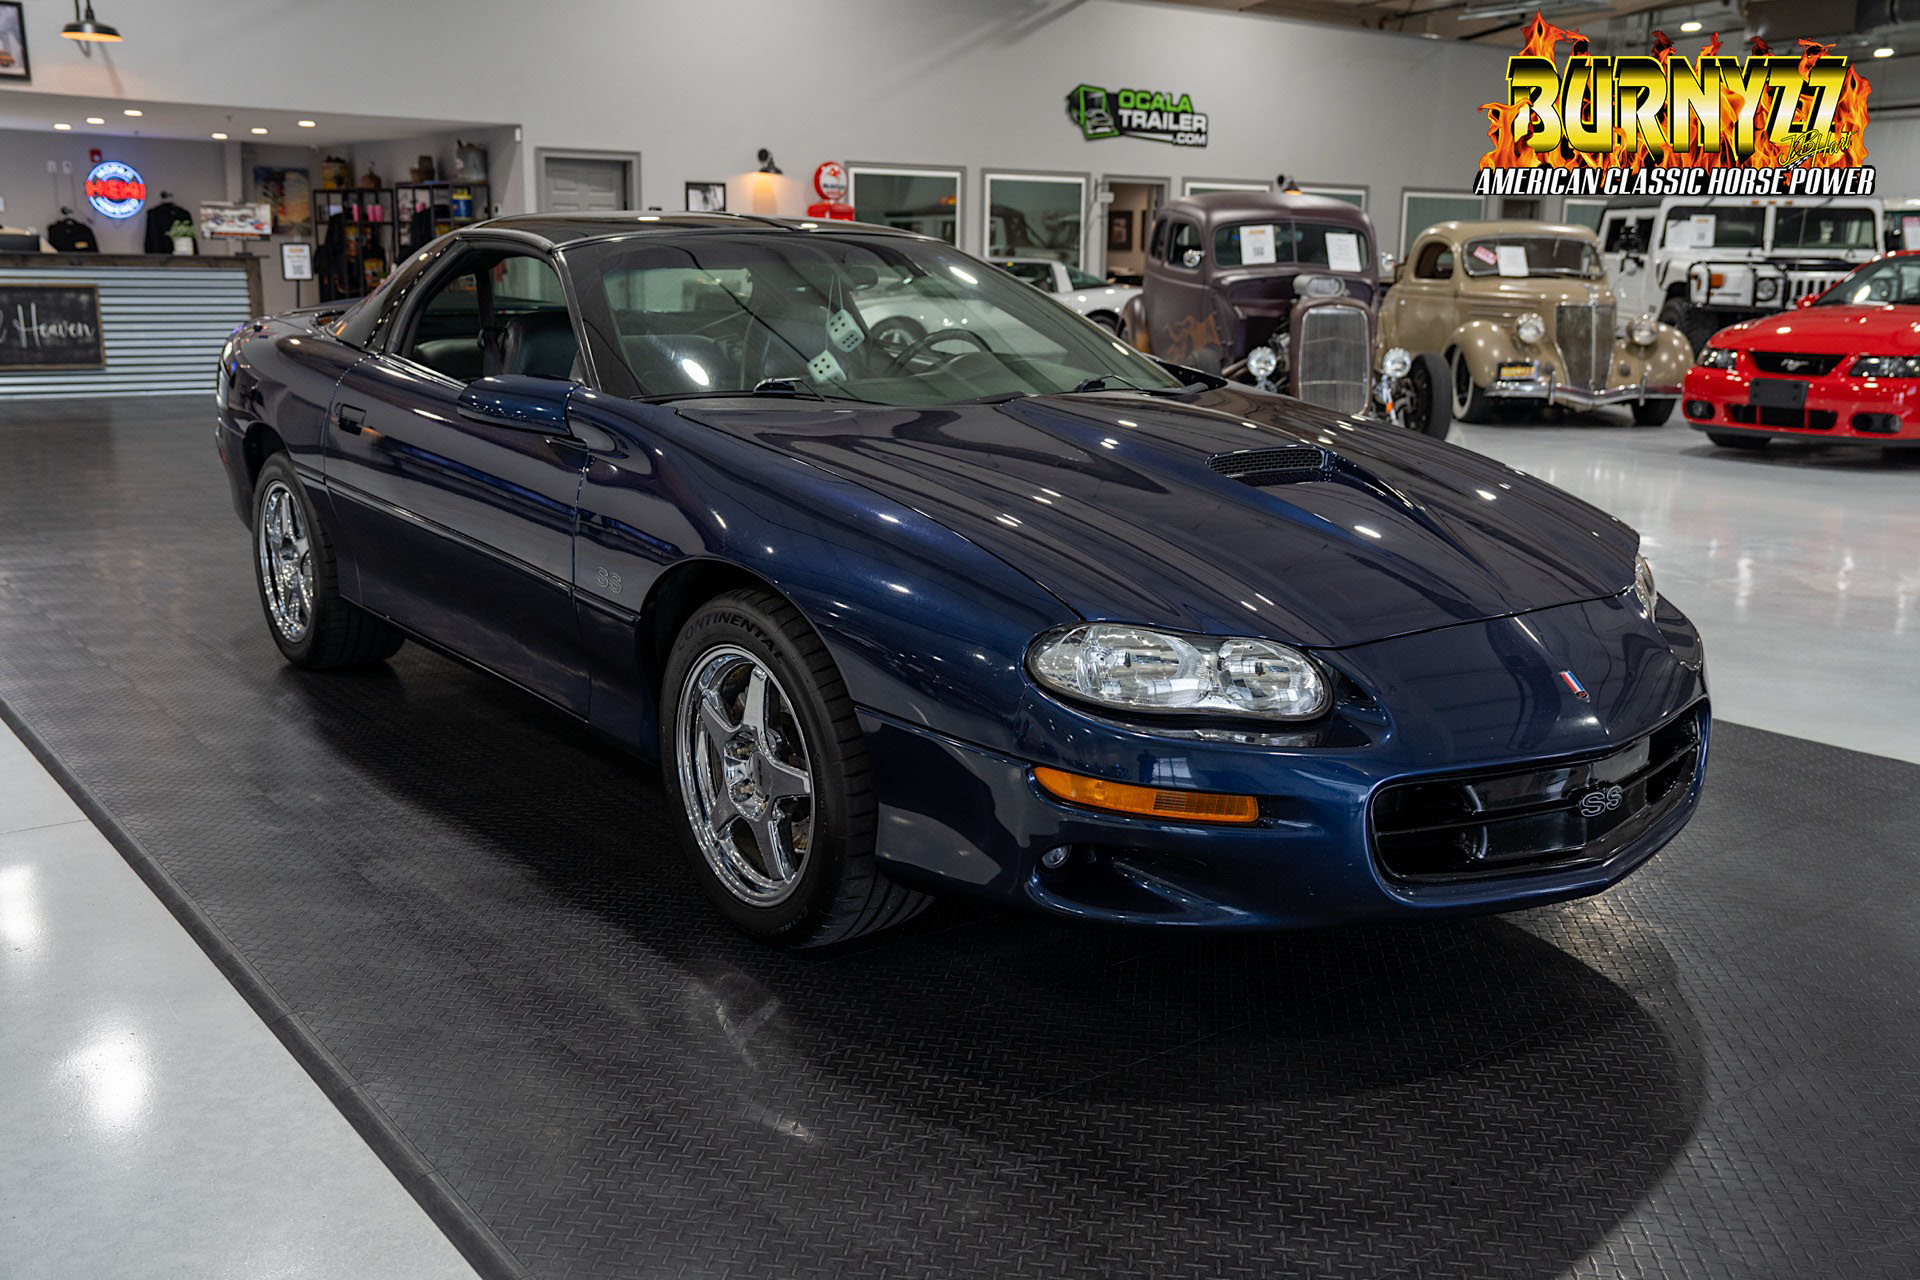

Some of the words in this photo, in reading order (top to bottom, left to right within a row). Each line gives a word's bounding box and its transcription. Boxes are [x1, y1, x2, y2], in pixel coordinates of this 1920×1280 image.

[1118, 90, 1193, 113] OCALA
[1118, 109, 1207, 132] TRAILER
[12, 302, 96, 349] Heaven
[597, 565, 623, 594] SS
[678, 611, 784, 665] CONTINENTAL
[1581, 785, 1624, 818] SS
